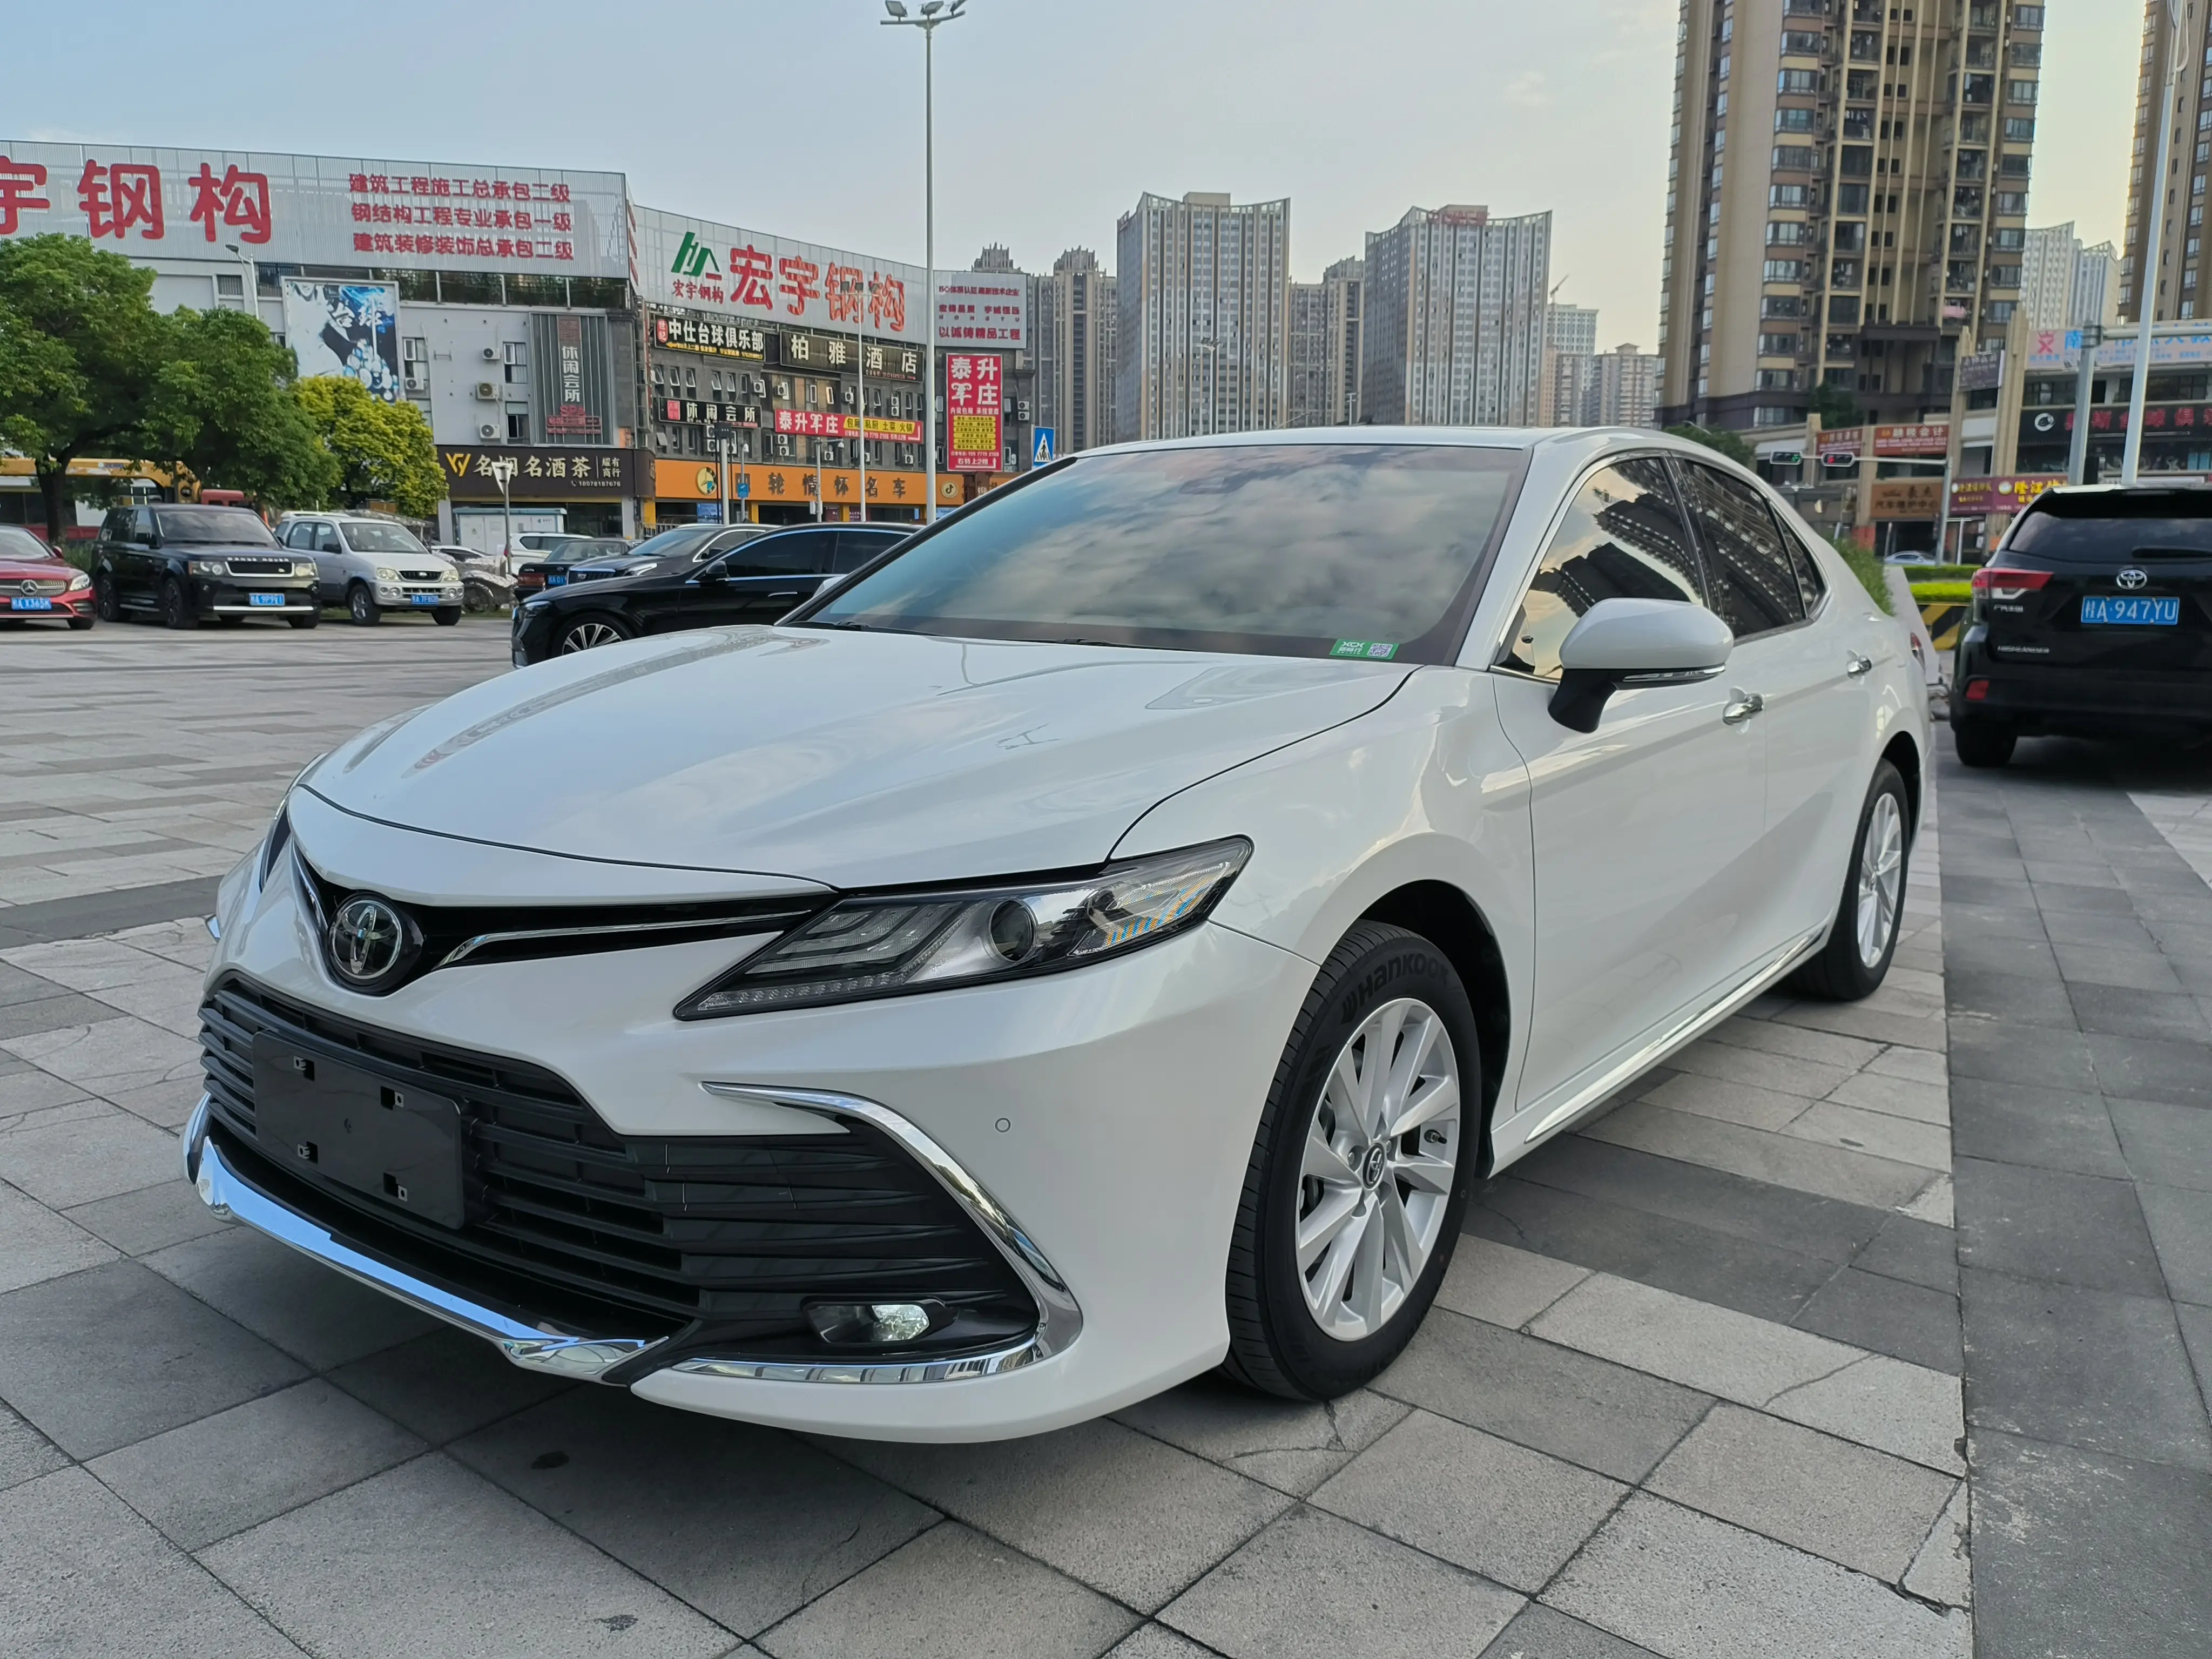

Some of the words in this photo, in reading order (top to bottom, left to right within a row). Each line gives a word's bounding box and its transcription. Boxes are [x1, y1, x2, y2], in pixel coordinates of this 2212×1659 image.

[349, 173, 571, 203] 建筑工程施工总承包二级
[351, 202, 572, 232] 钢结构工程专业承包一级
[353, 233, 574, 260] 建筑装修装饰总承包二级
[730, 245, 905, 333] 宏宇钢构
[669, 318, 764, 352] 中仕台球俱乐部
[791, 335, 917, 374] 柏雅酒店
[951, 356, 998, 381] 泰升
[562, 346, 581, 402] 休闲会所
[560, 404, 586, 417] SPA
[686, 402, 755, 422] 休闲会所
